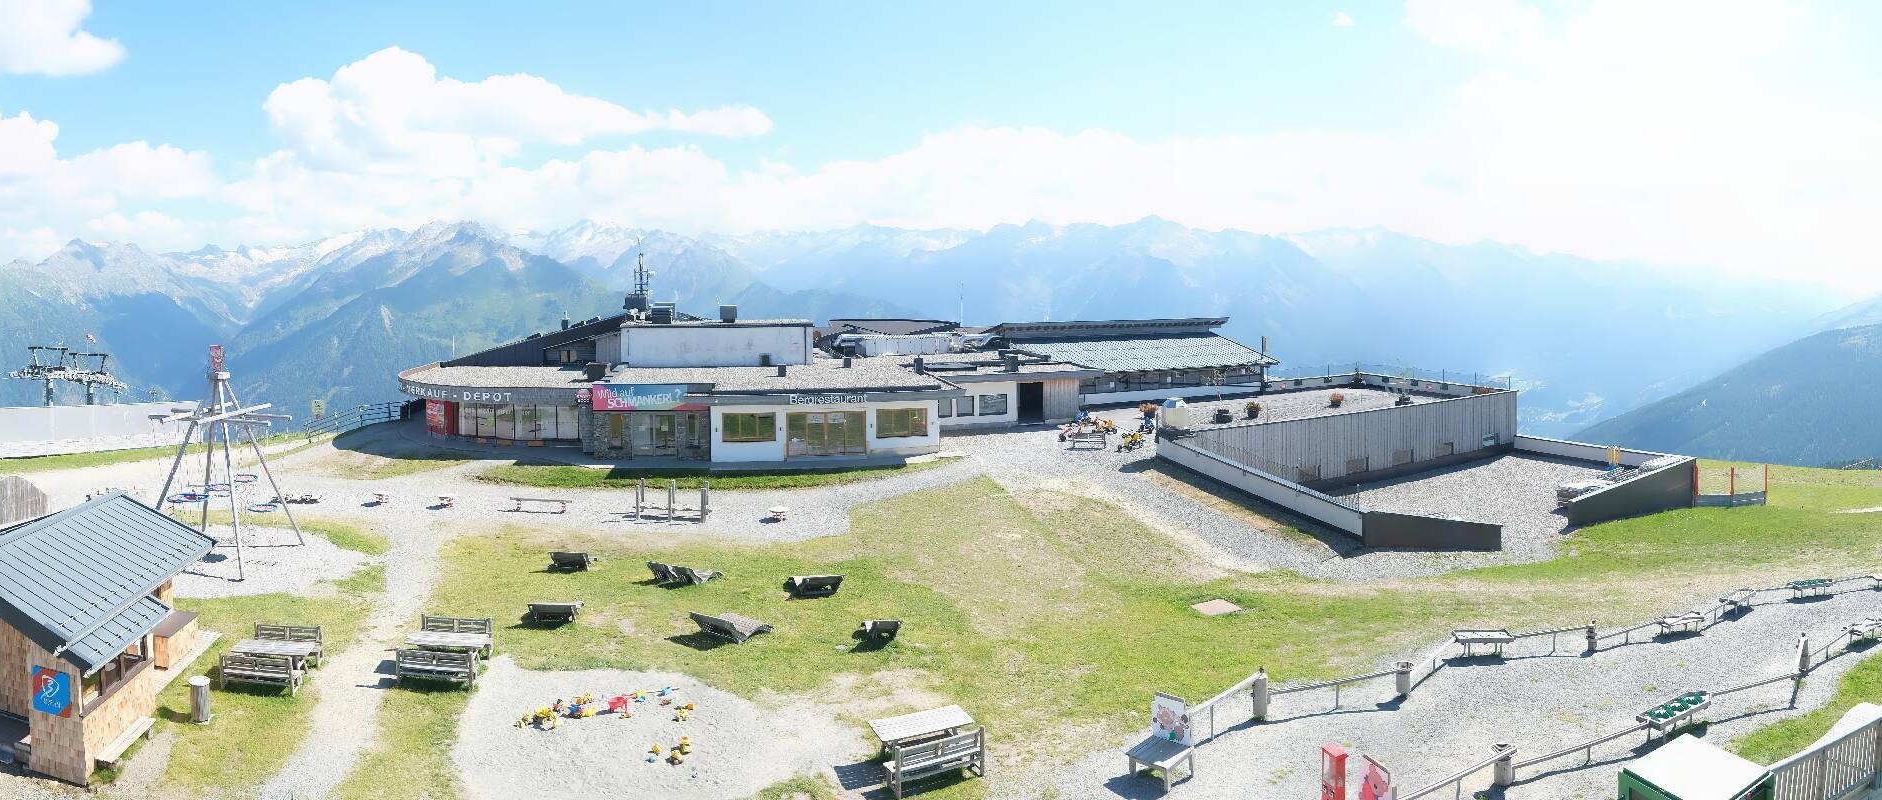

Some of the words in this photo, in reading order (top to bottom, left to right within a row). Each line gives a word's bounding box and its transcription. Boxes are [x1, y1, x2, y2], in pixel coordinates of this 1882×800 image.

[406, 384, 448, 399] VERKAUF
[463, 391, 512, 402] DEPOT
[597, 387, 617, 399] Wild
[619, 386, 635, 398] auf
[789, 393, 868, 405] Bergrestaurant
